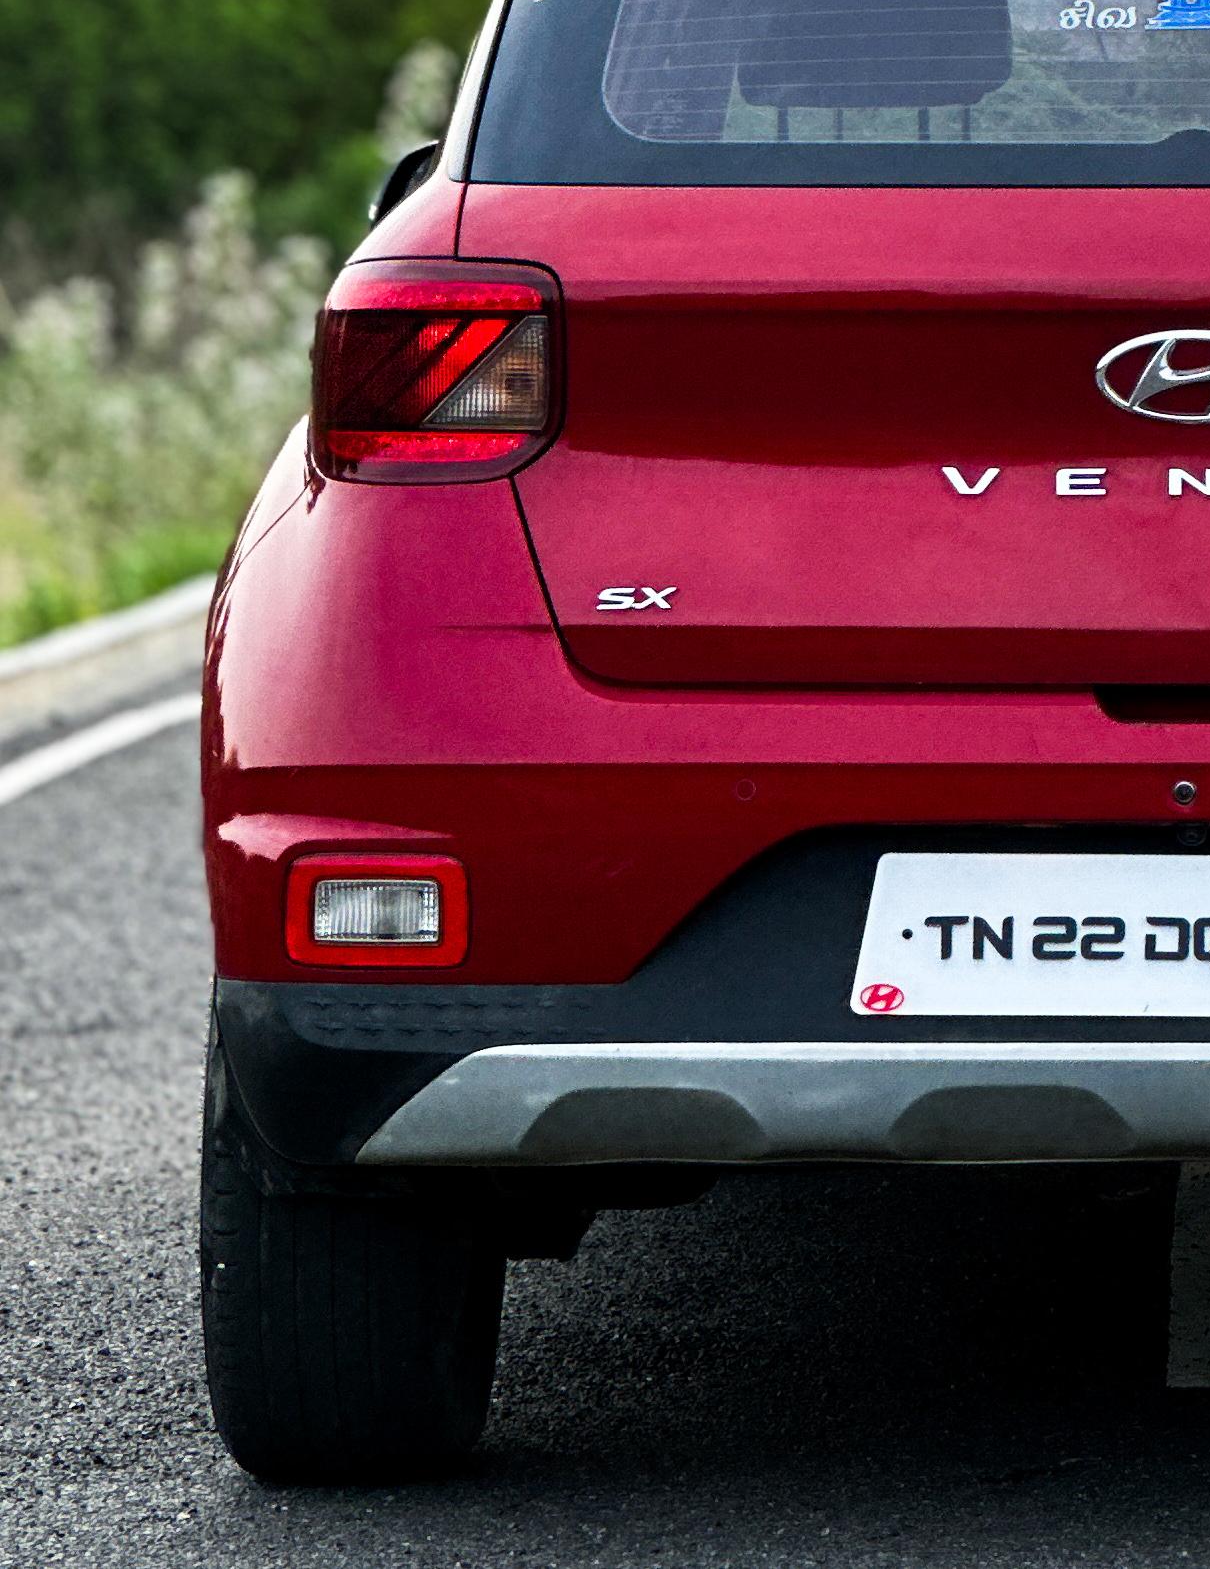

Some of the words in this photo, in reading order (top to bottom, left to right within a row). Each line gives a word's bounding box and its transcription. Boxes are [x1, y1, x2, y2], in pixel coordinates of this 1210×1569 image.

[596, 586, 677, 611] SX
[924, 915, 1014, 960] TN
[1032, 916, 1126, 961] 22
